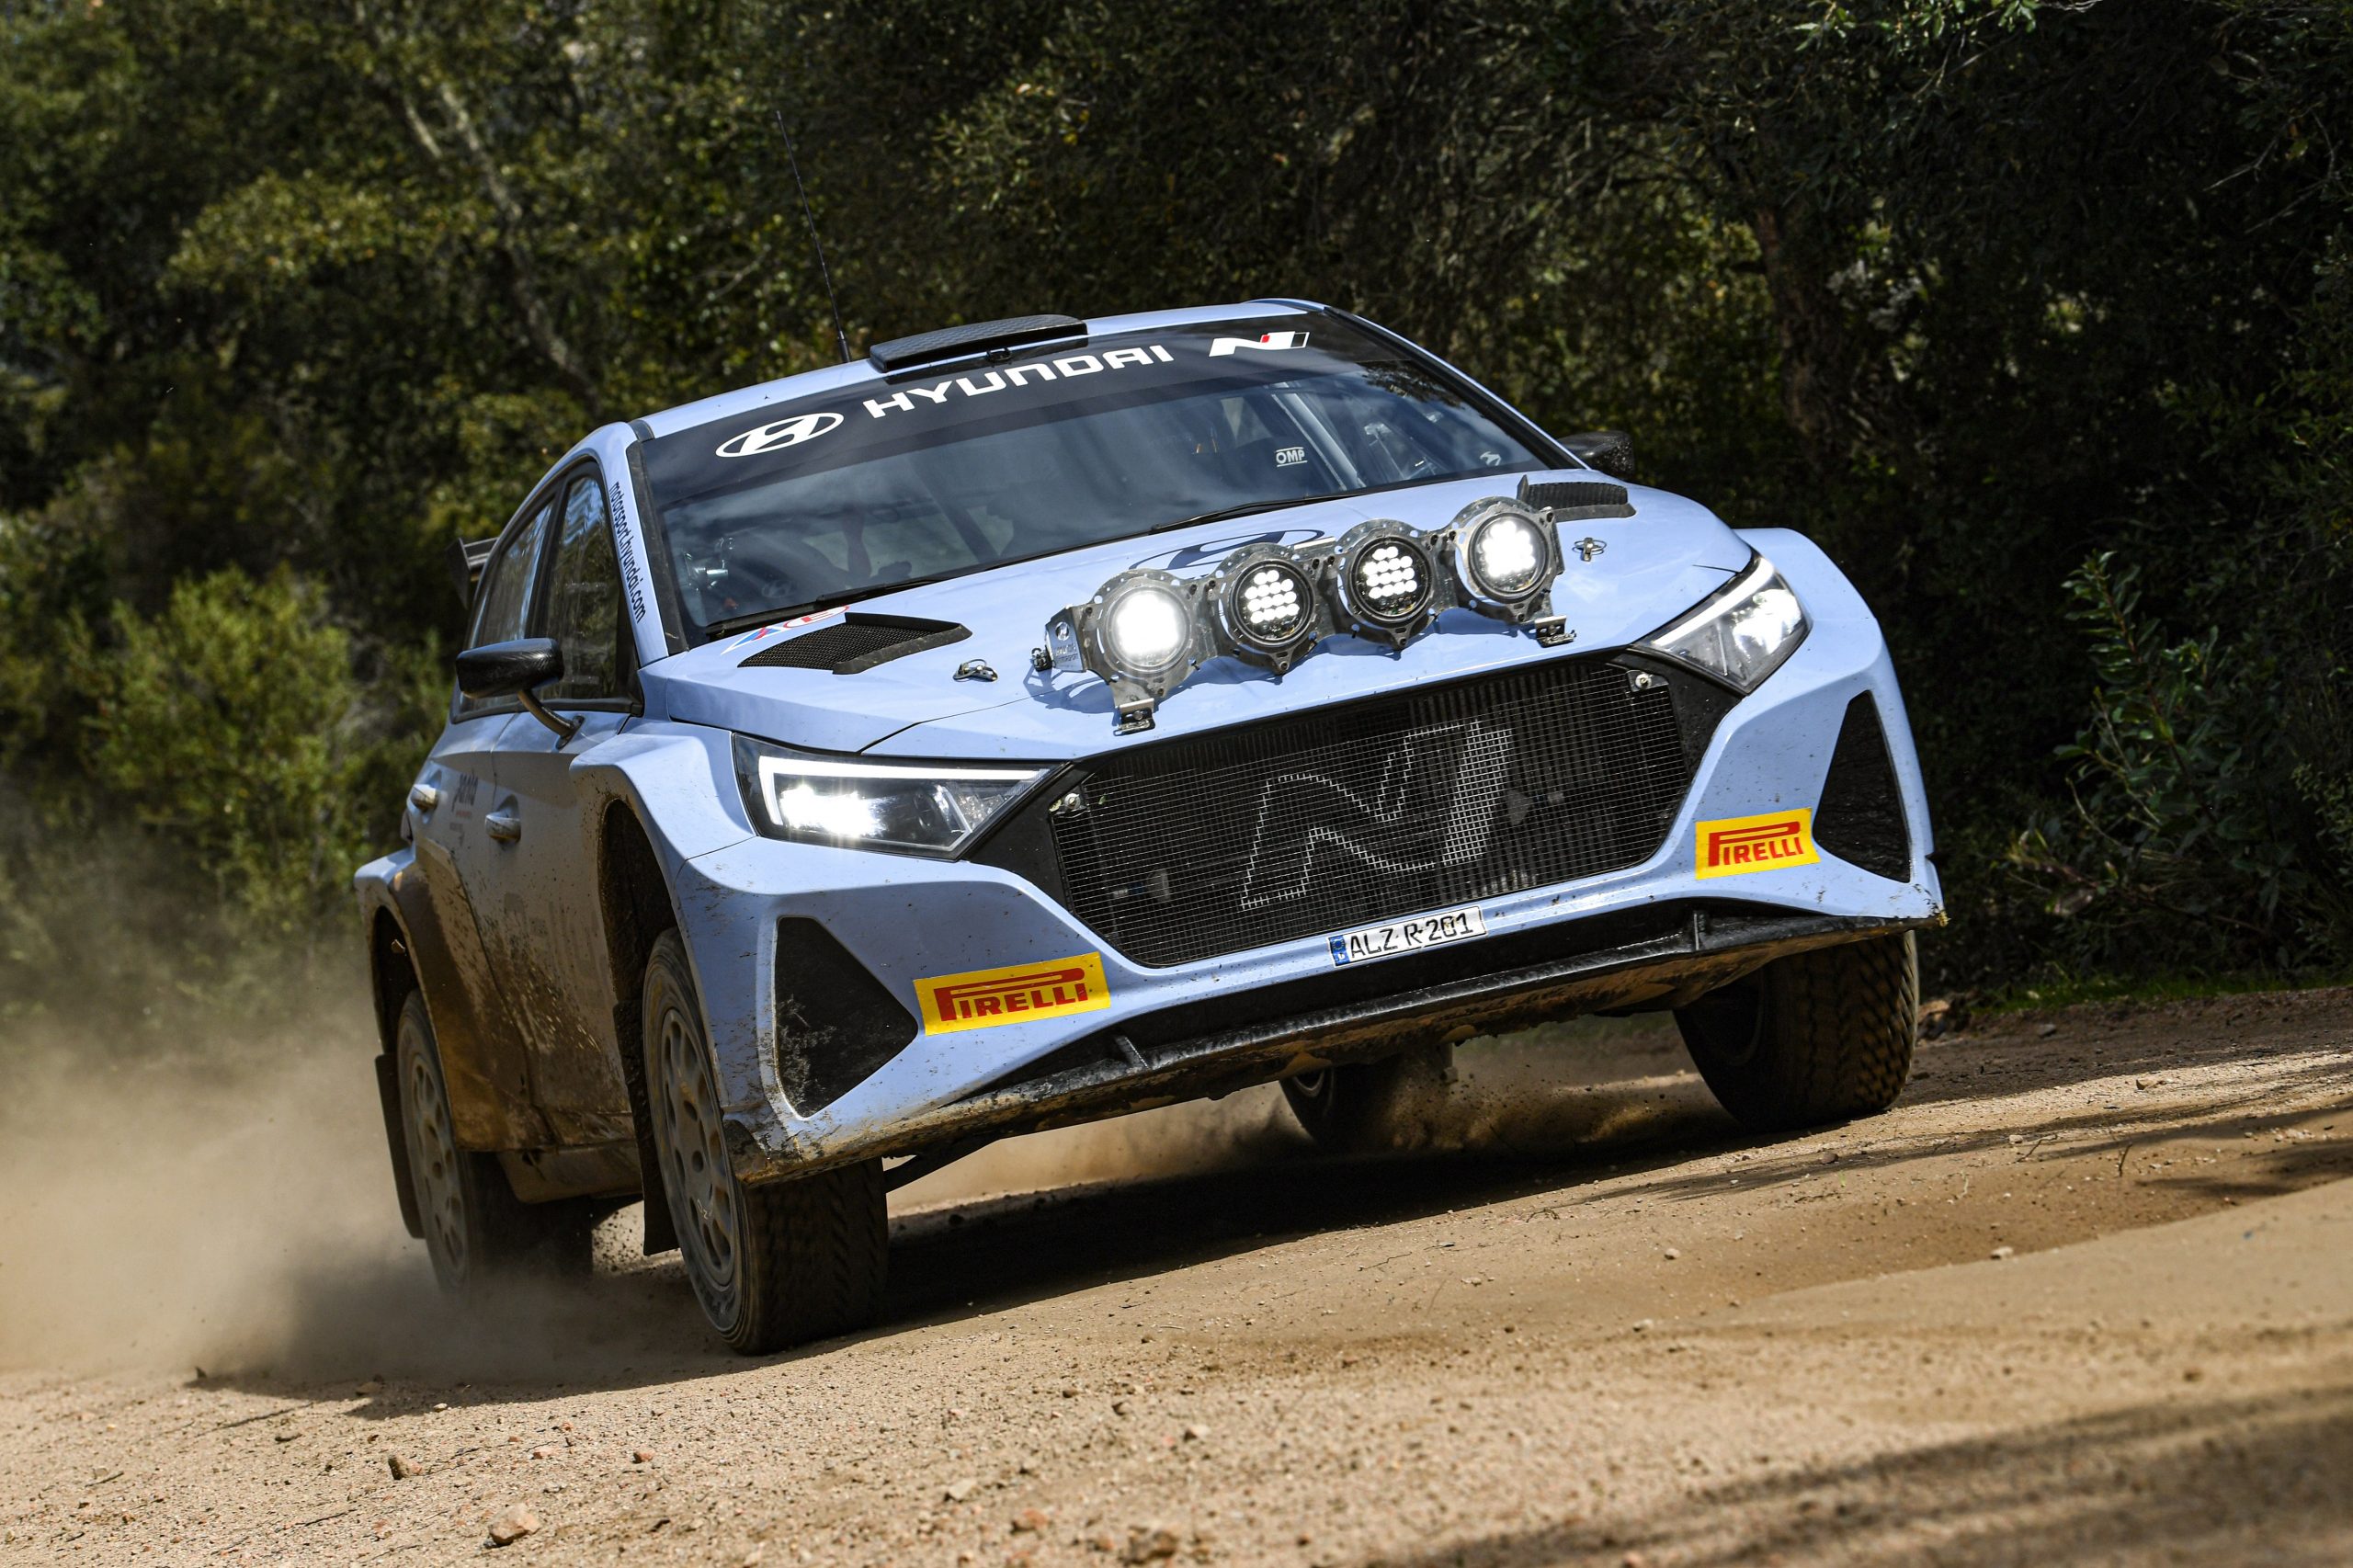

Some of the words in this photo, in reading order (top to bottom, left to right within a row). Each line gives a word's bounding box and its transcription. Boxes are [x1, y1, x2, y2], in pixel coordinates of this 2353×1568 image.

[863, 345, 1174, 419] HYUNDAI
[1276, 449, 1305, 464] OMP
[608, 481, 647, 624] motorsport.hyundai.com
[1708, 821, 1804, 867] PIRELLI
[1349, 927, 1398, 959] ALZ
[1426, 913, 1472, 941] 201
[934, 968, 1088, 1021] PIRELLI
